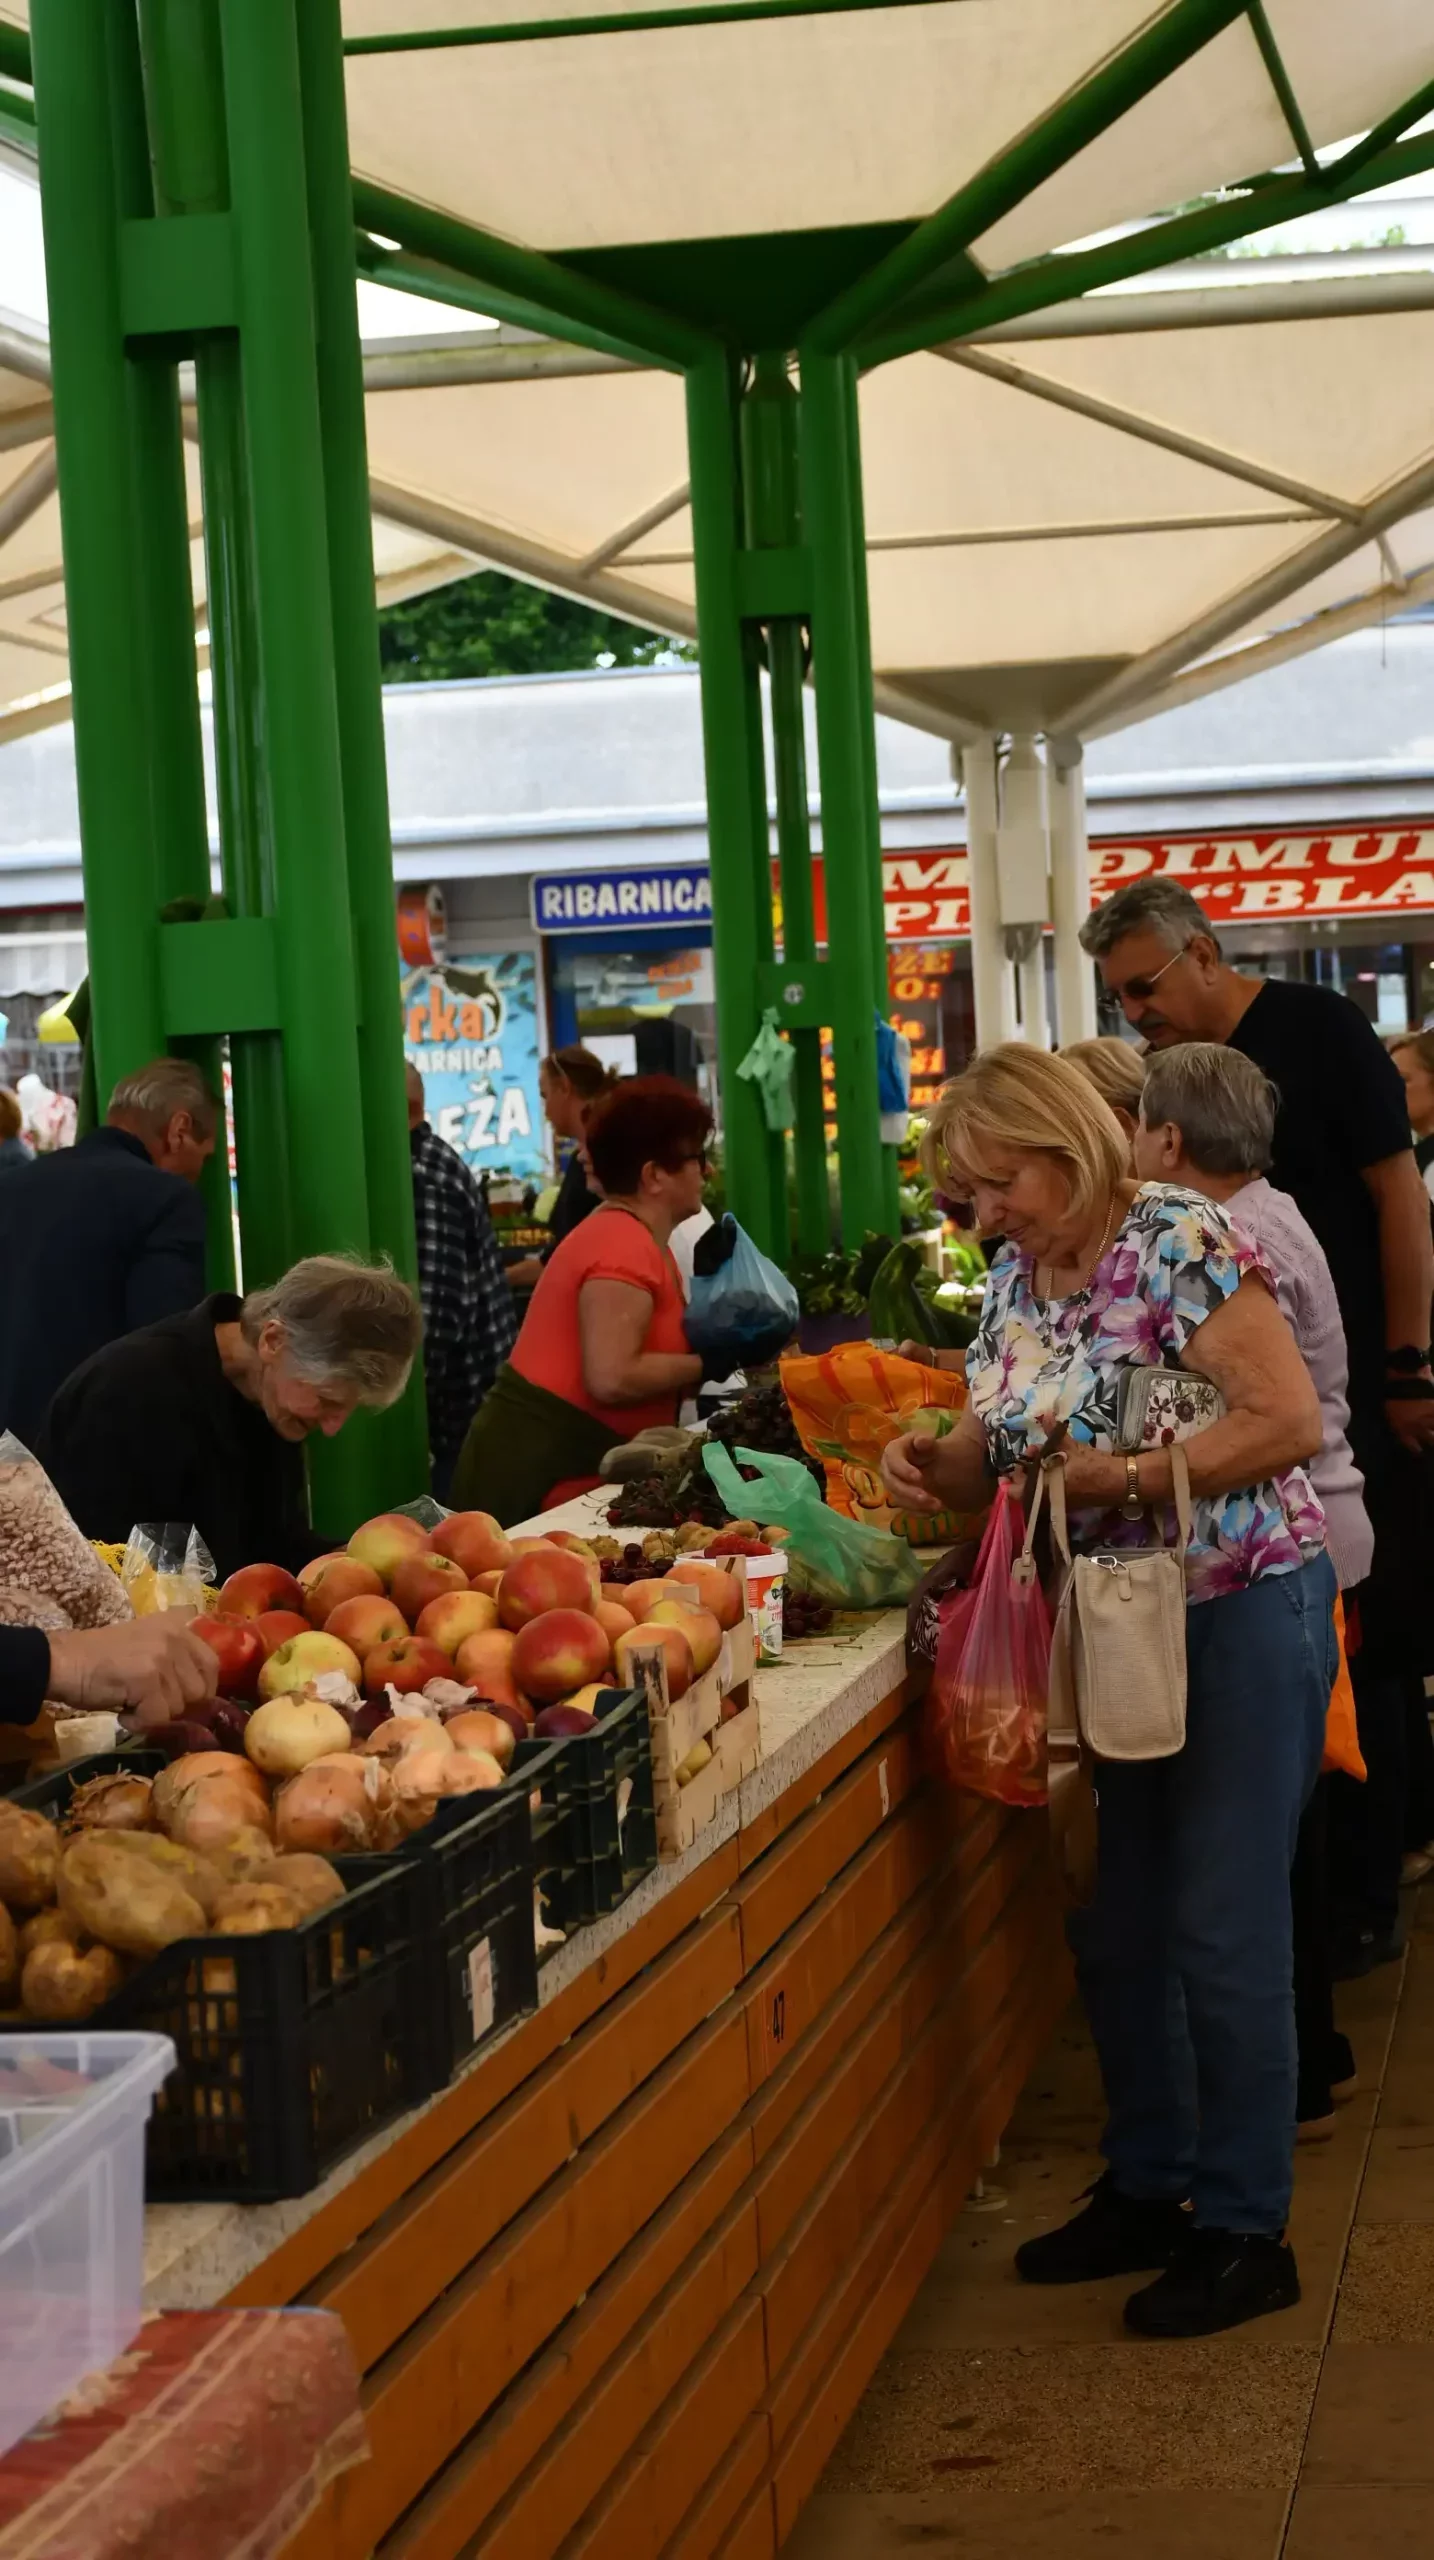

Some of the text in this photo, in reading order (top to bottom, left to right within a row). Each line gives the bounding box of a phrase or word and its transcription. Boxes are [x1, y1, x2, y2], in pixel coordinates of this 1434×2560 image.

[541, 876, 711, 919] RIBARNICA
[403, 985, 484, 1043] rka
[404, 1045, 503, 1074] ARNICA
[426, 1079, 531, 1154] EŽA
